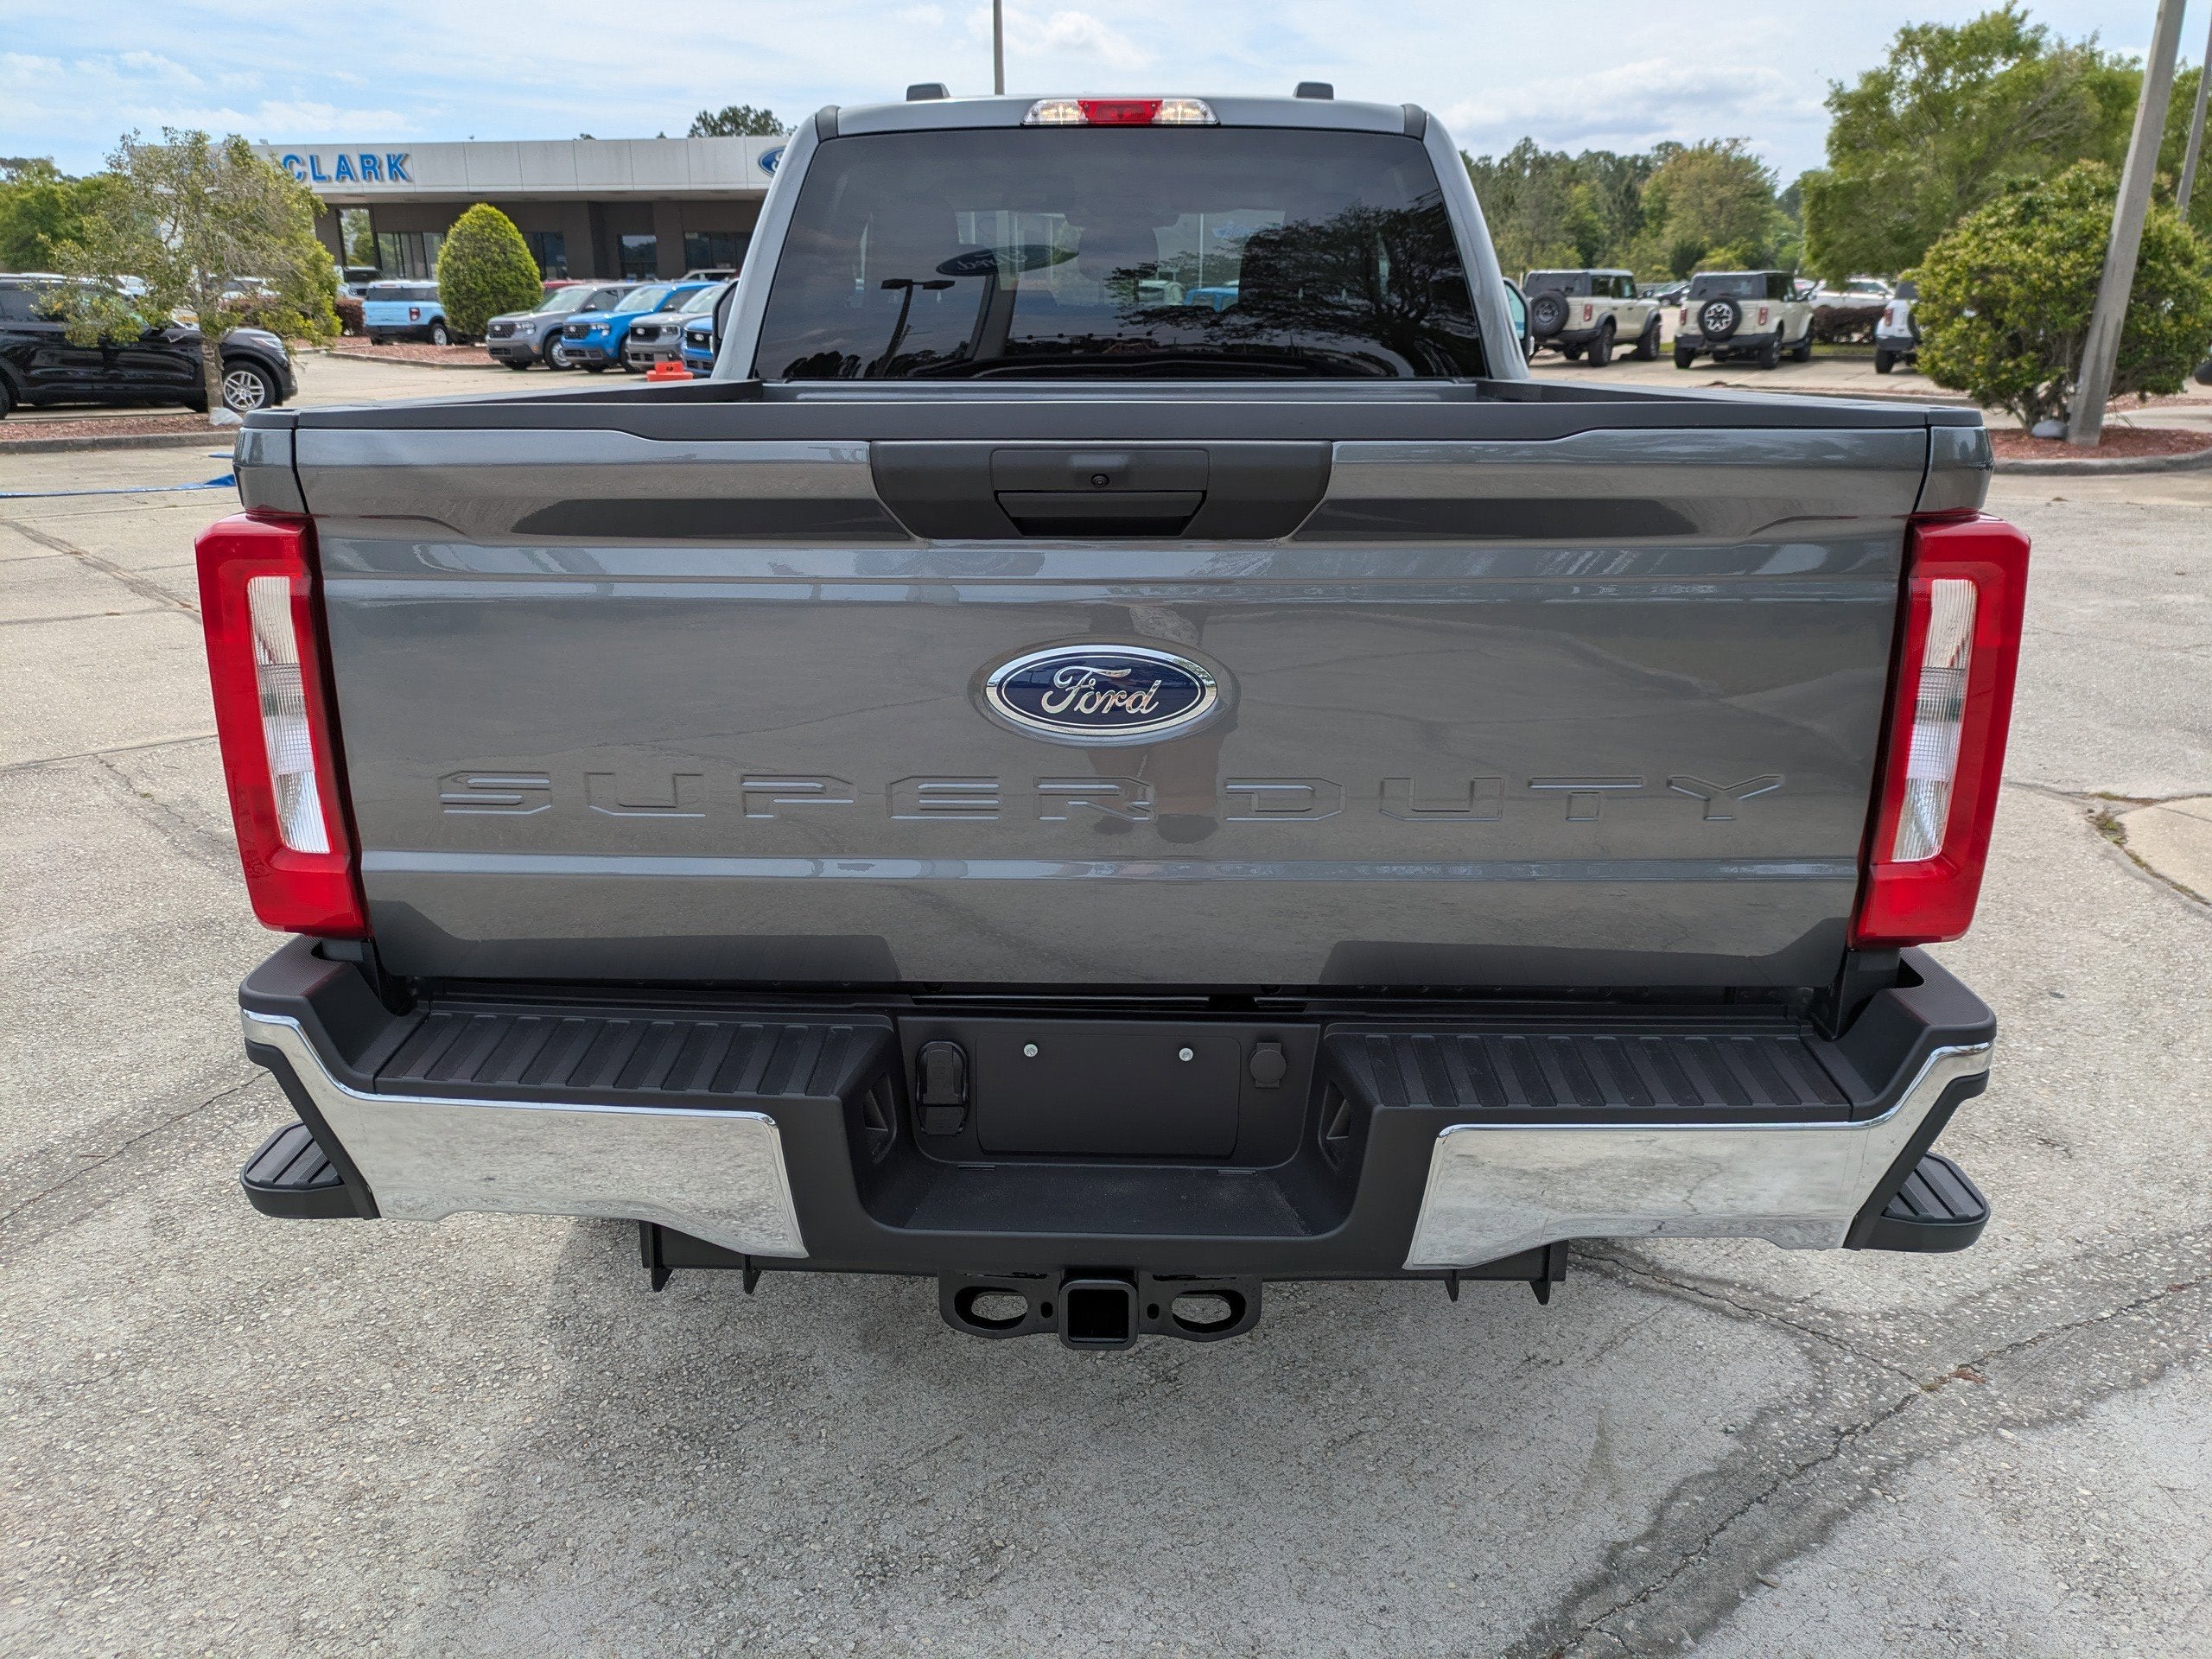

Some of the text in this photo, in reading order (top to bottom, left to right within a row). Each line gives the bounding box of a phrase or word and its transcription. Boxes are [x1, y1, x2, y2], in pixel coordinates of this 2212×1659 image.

[283, 153, 410, 182] CLARK
[1041, 664, 1162, 715] Ford
[438, 769, 1785, 822] SUPER DUTY
